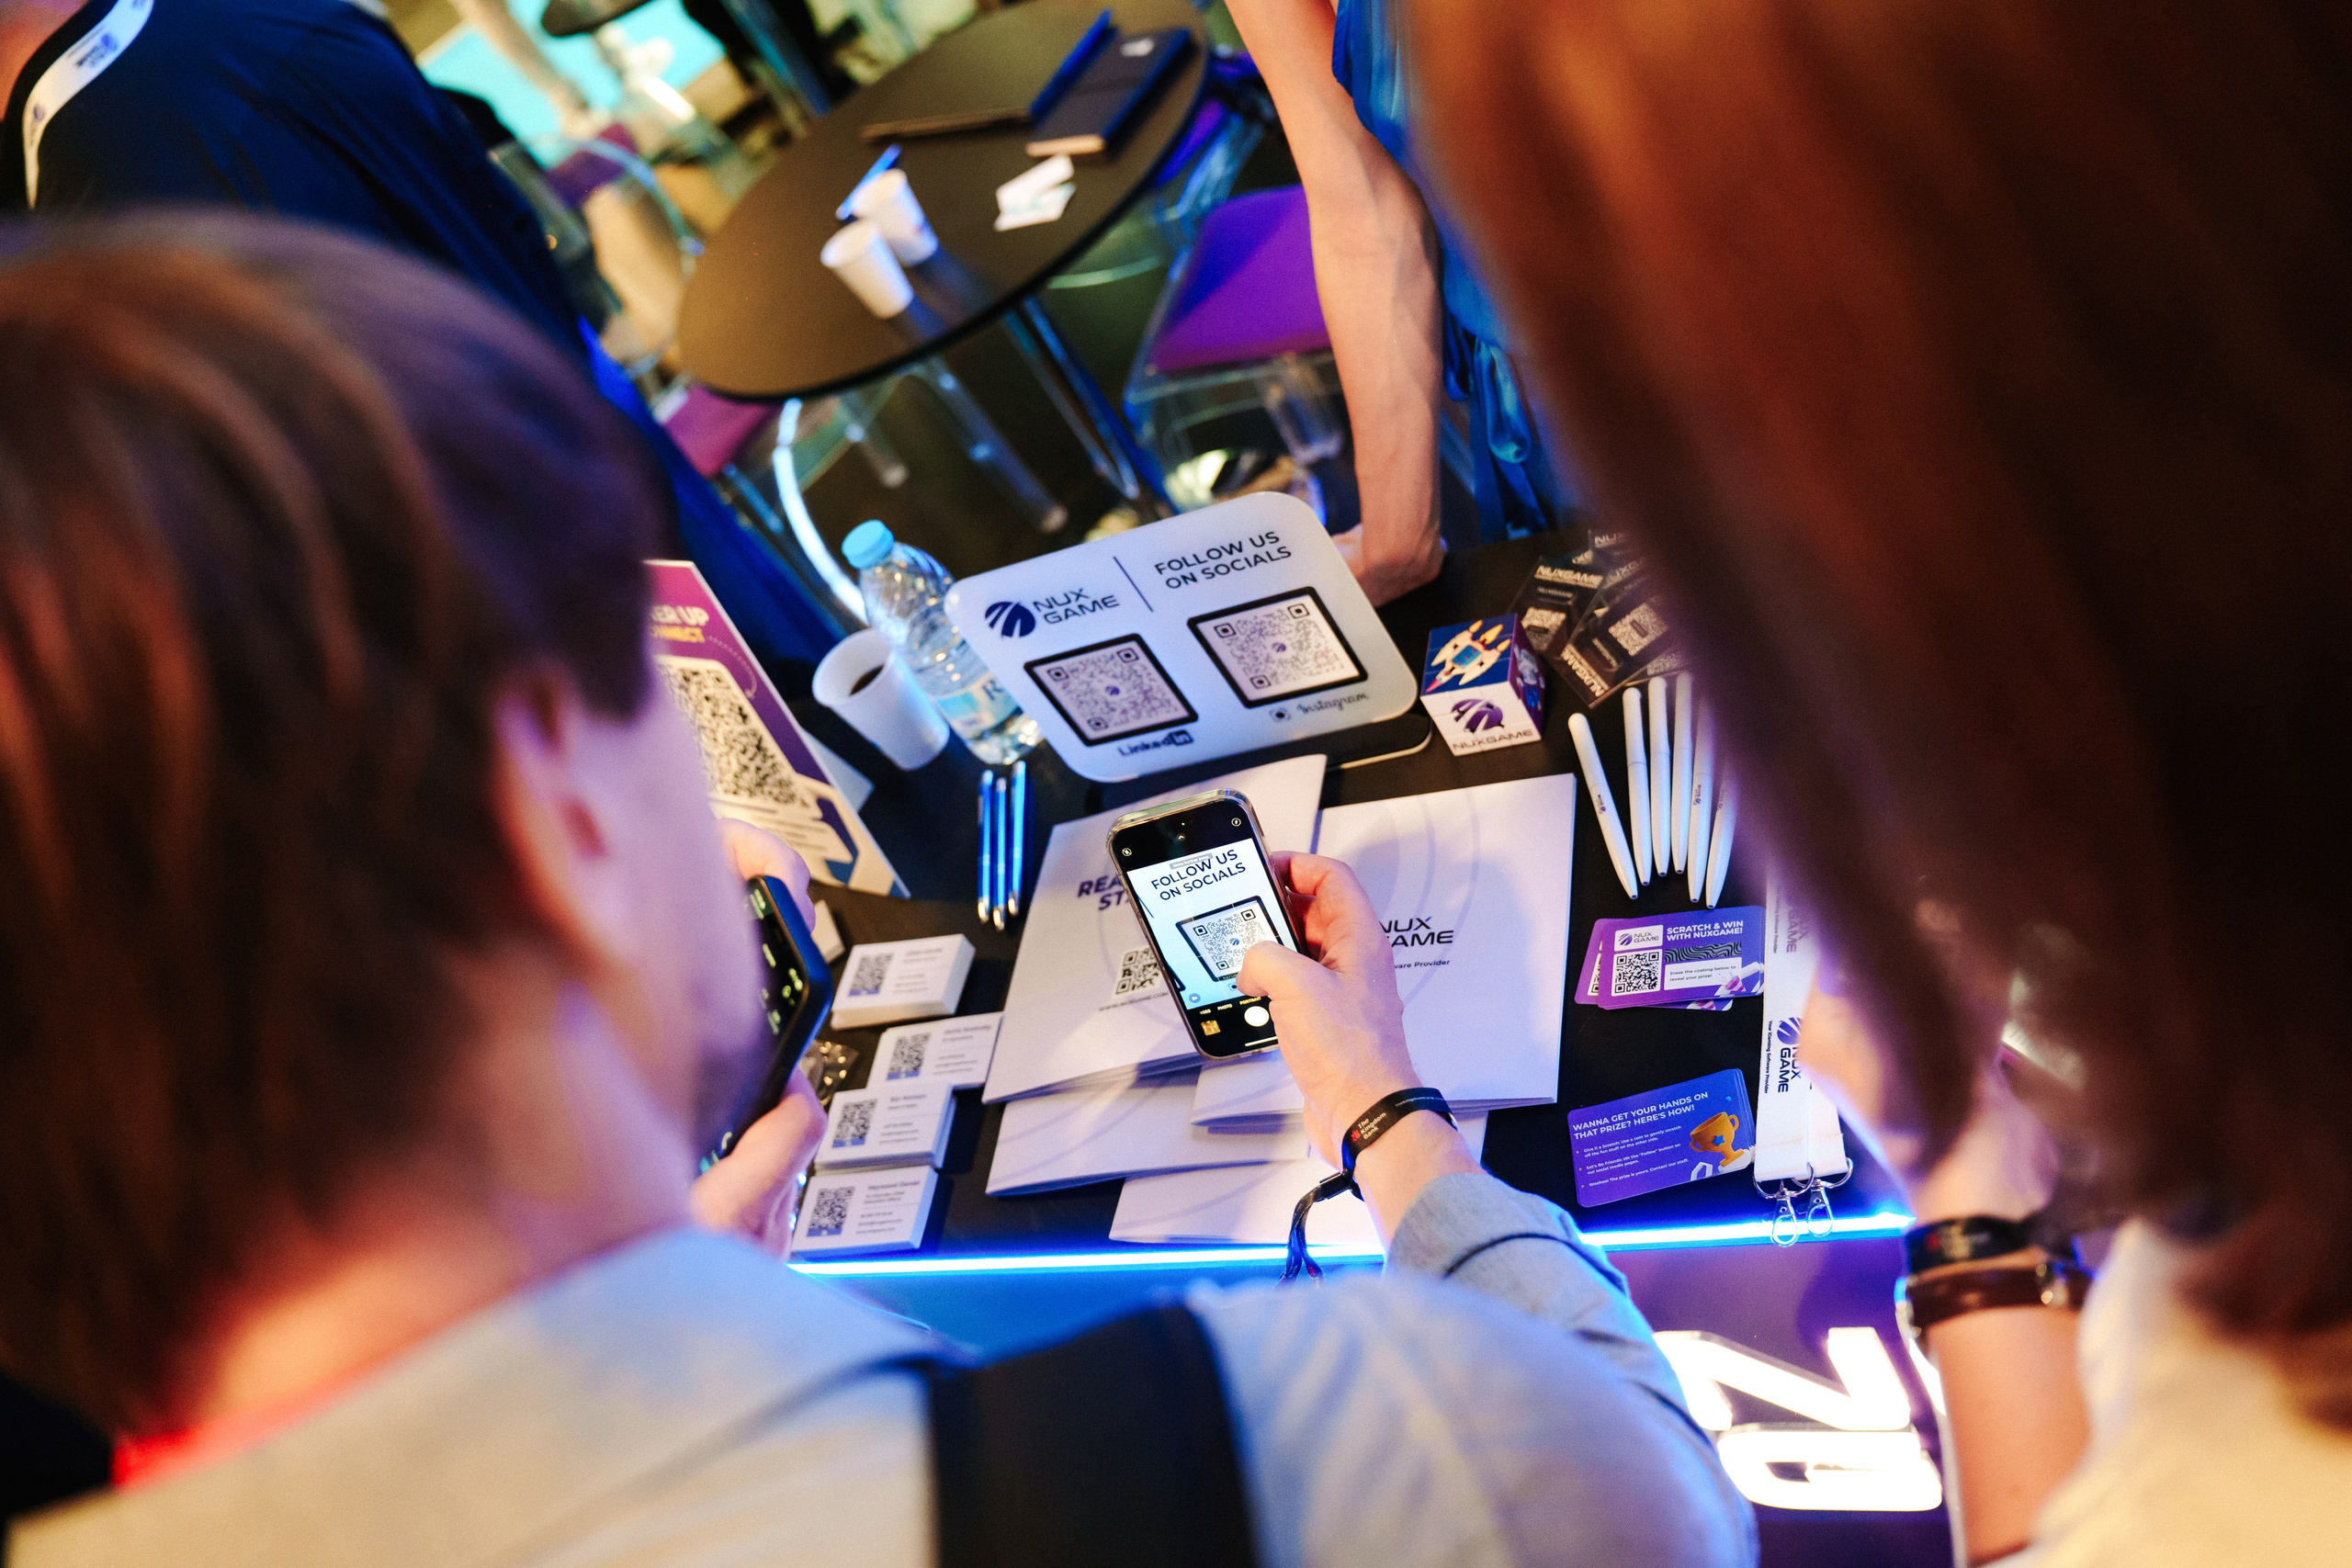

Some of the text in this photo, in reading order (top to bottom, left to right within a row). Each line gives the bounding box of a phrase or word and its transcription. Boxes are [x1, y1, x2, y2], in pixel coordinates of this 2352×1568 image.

[1154, 531, 1280, 575] FOLLOW US
[1166, 547, 1291, 589] ON SOCIALS
[1535, 565, 1603, 587] NUXGAME
[1033, 588, 1090, 612] NUX
[1044, 595, 1120, 624] GAME
[676, 605, 709, 626] UP
[1296, 693, 1369, 714] Instagram
[1453, 728, 1533, 750] NUXGAME
[1151, 849, 1238, 890] FOLLOW US
[1077, 875, 1124, 897] REA
[1159, 862, 1246, 900] ON SOCIALS
[1098, 890, 1129, 910] ST
[1667, 923, 1712, 935] SCRATCH
[1723, 920, 1744, 929] WIN
[1667, 927, 1743, 942] WITH NUXGAME!
[1387, 930, 1453, 948] AME
[1239, 996, 1261, 1005] PORTRAIT
[1778, 1047, 1792, 1093] GAME
[1572, 1091, 1709, 1132] WANNA GET YOUR HANDS ON
[1573, 1104, 1695, 1140] THAT PRIZE? HERE'S HOW!
[1358, 1118, 1370, 1129] The
[1360, 1111, 1387, 1135] Kingdom
[1363, 1126, 1379, 1140] Bank
[1649, 1163, 1667, 1171] Contact
